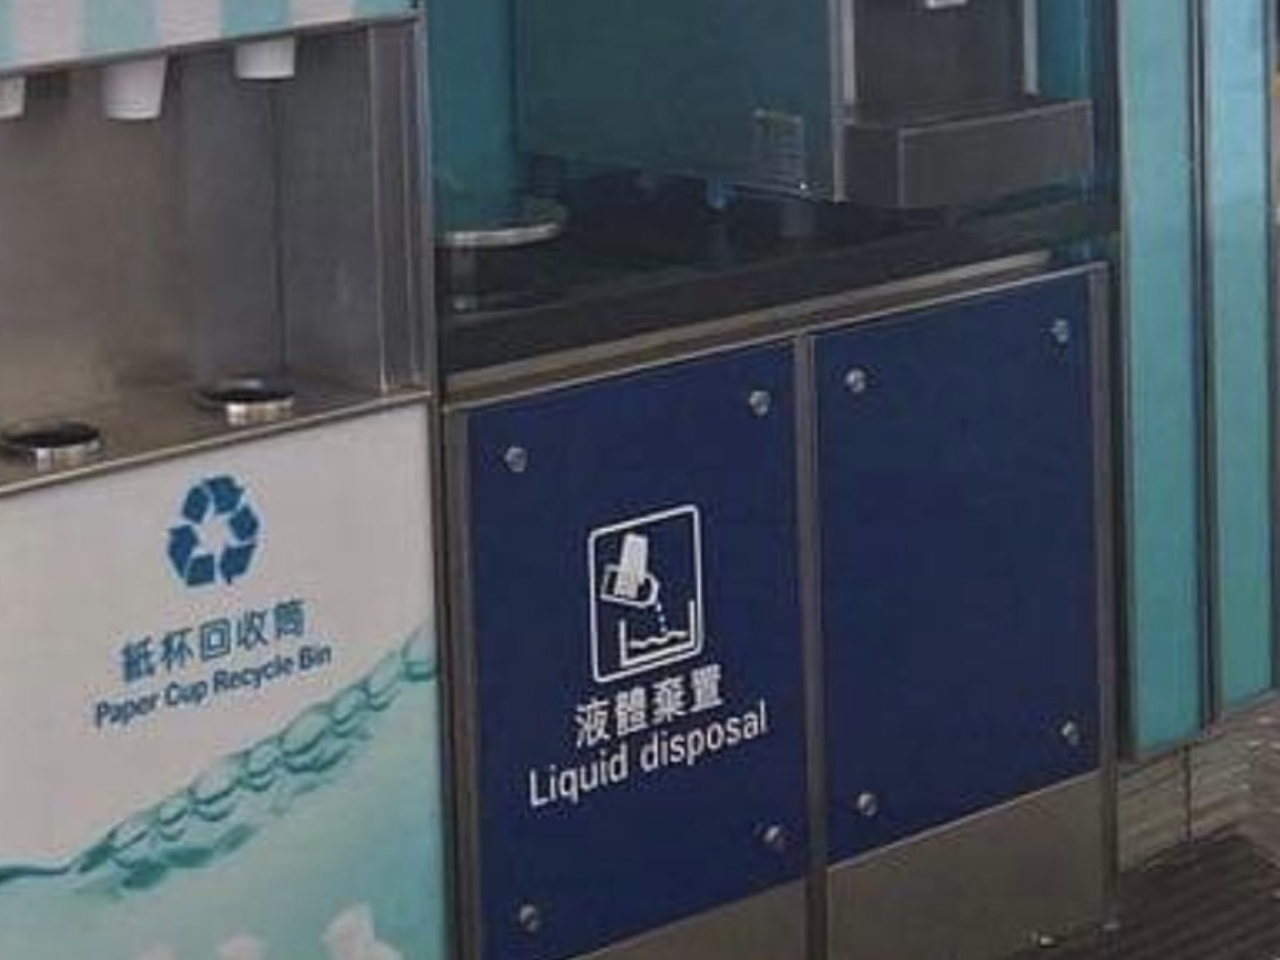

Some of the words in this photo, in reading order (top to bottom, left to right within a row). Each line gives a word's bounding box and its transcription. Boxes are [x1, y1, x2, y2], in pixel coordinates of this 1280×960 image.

[94, 691, 158, 728] Paper
[164, 676, 208, 707] Cup
[213, 652, 295, 695] Recycle
[298, 642, 333, 672] Bin
[575, 663, 723, 747] 液體棄置
[529, 742, 629, 808] Liquid
[639, 698, 768, 772] disposal
